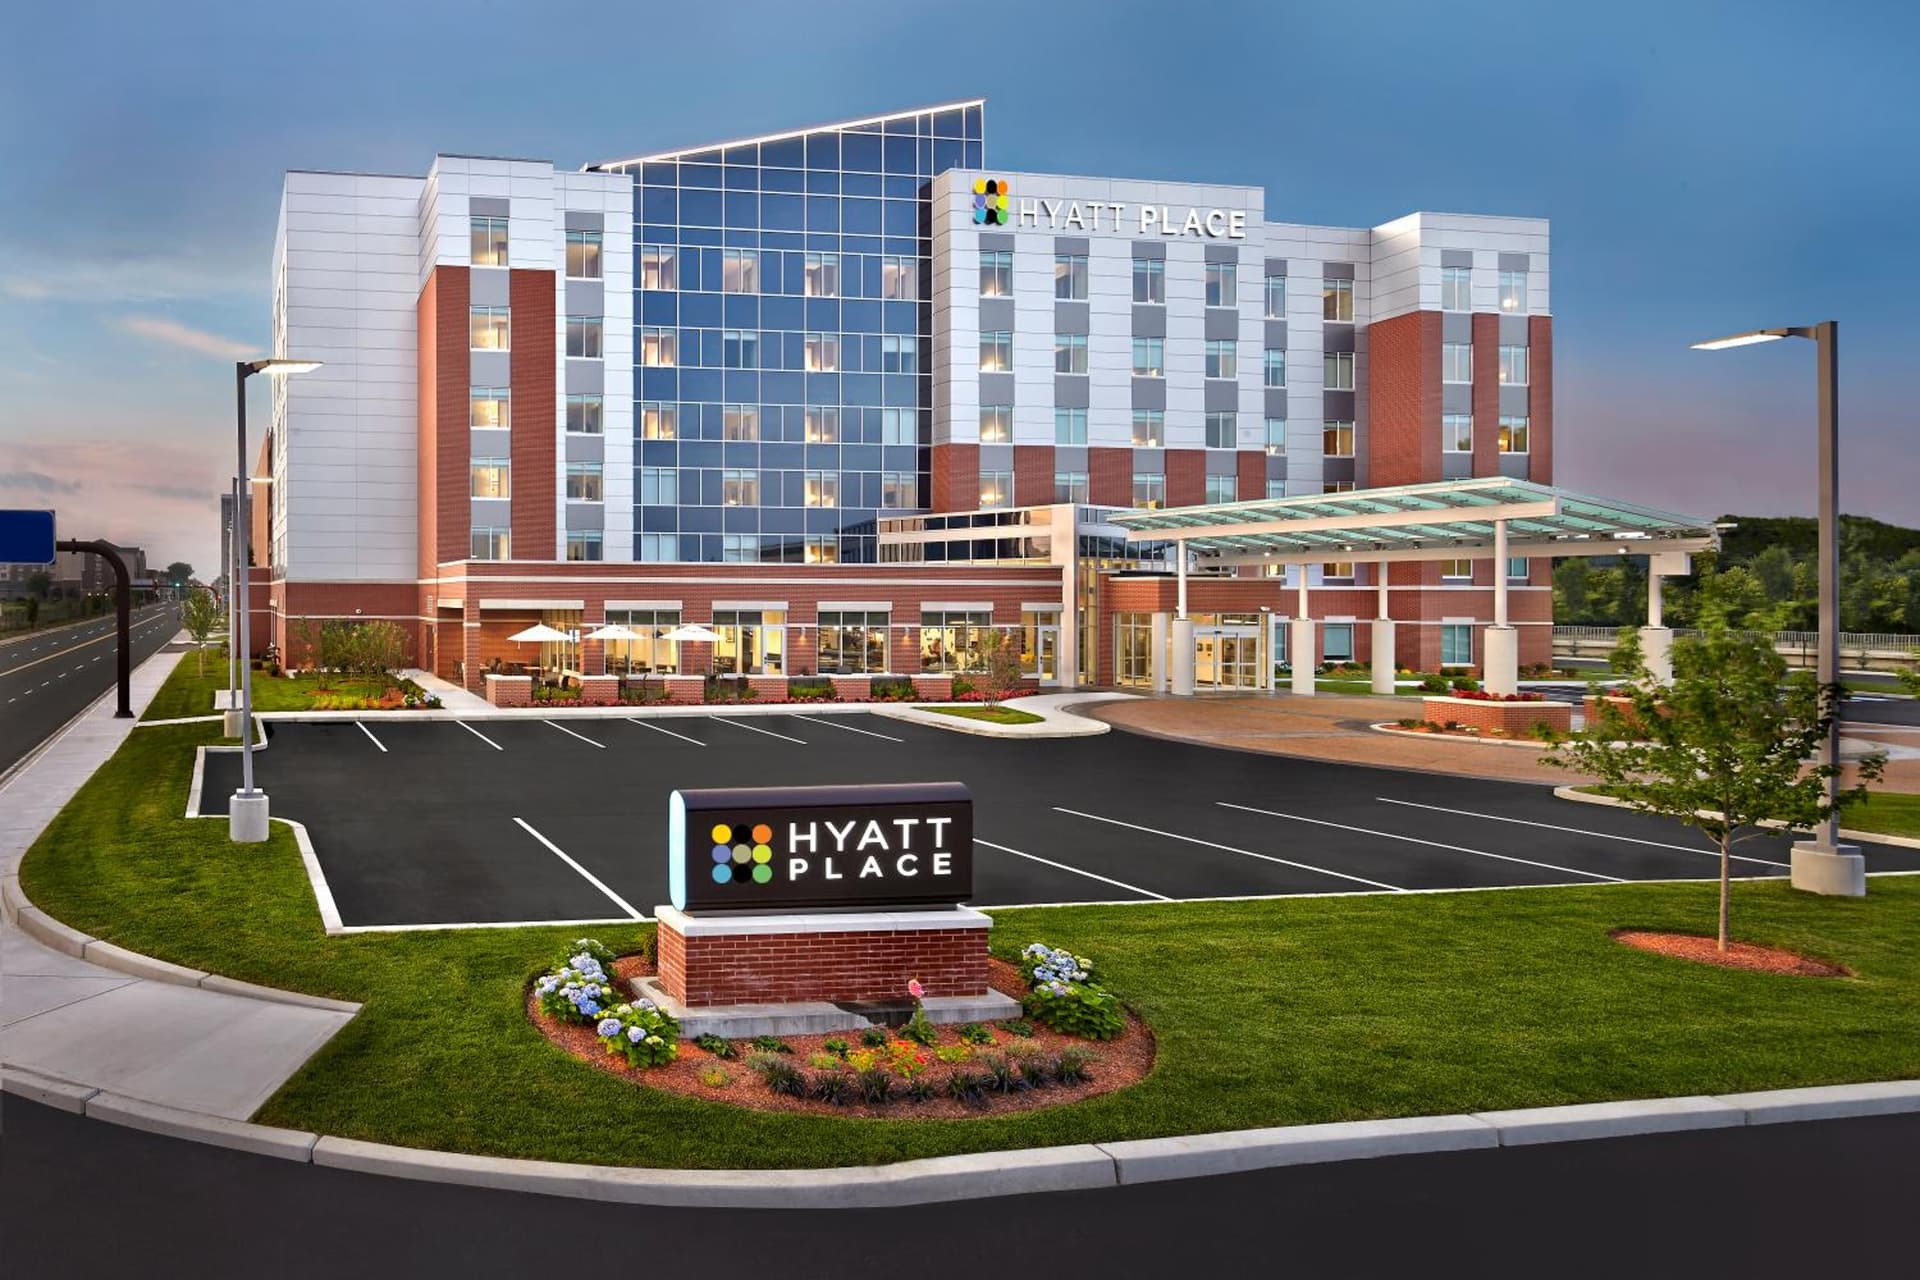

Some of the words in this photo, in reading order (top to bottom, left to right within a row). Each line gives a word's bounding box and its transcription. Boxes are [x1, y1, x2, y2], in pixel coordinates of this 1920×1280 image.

[1019, 199, 1126, 232] HYATT
[1139, 206, 1246, 238] PLACE
[788, 817, 953, 854] HYATT
[788, 853, 953, 882] PLACE
